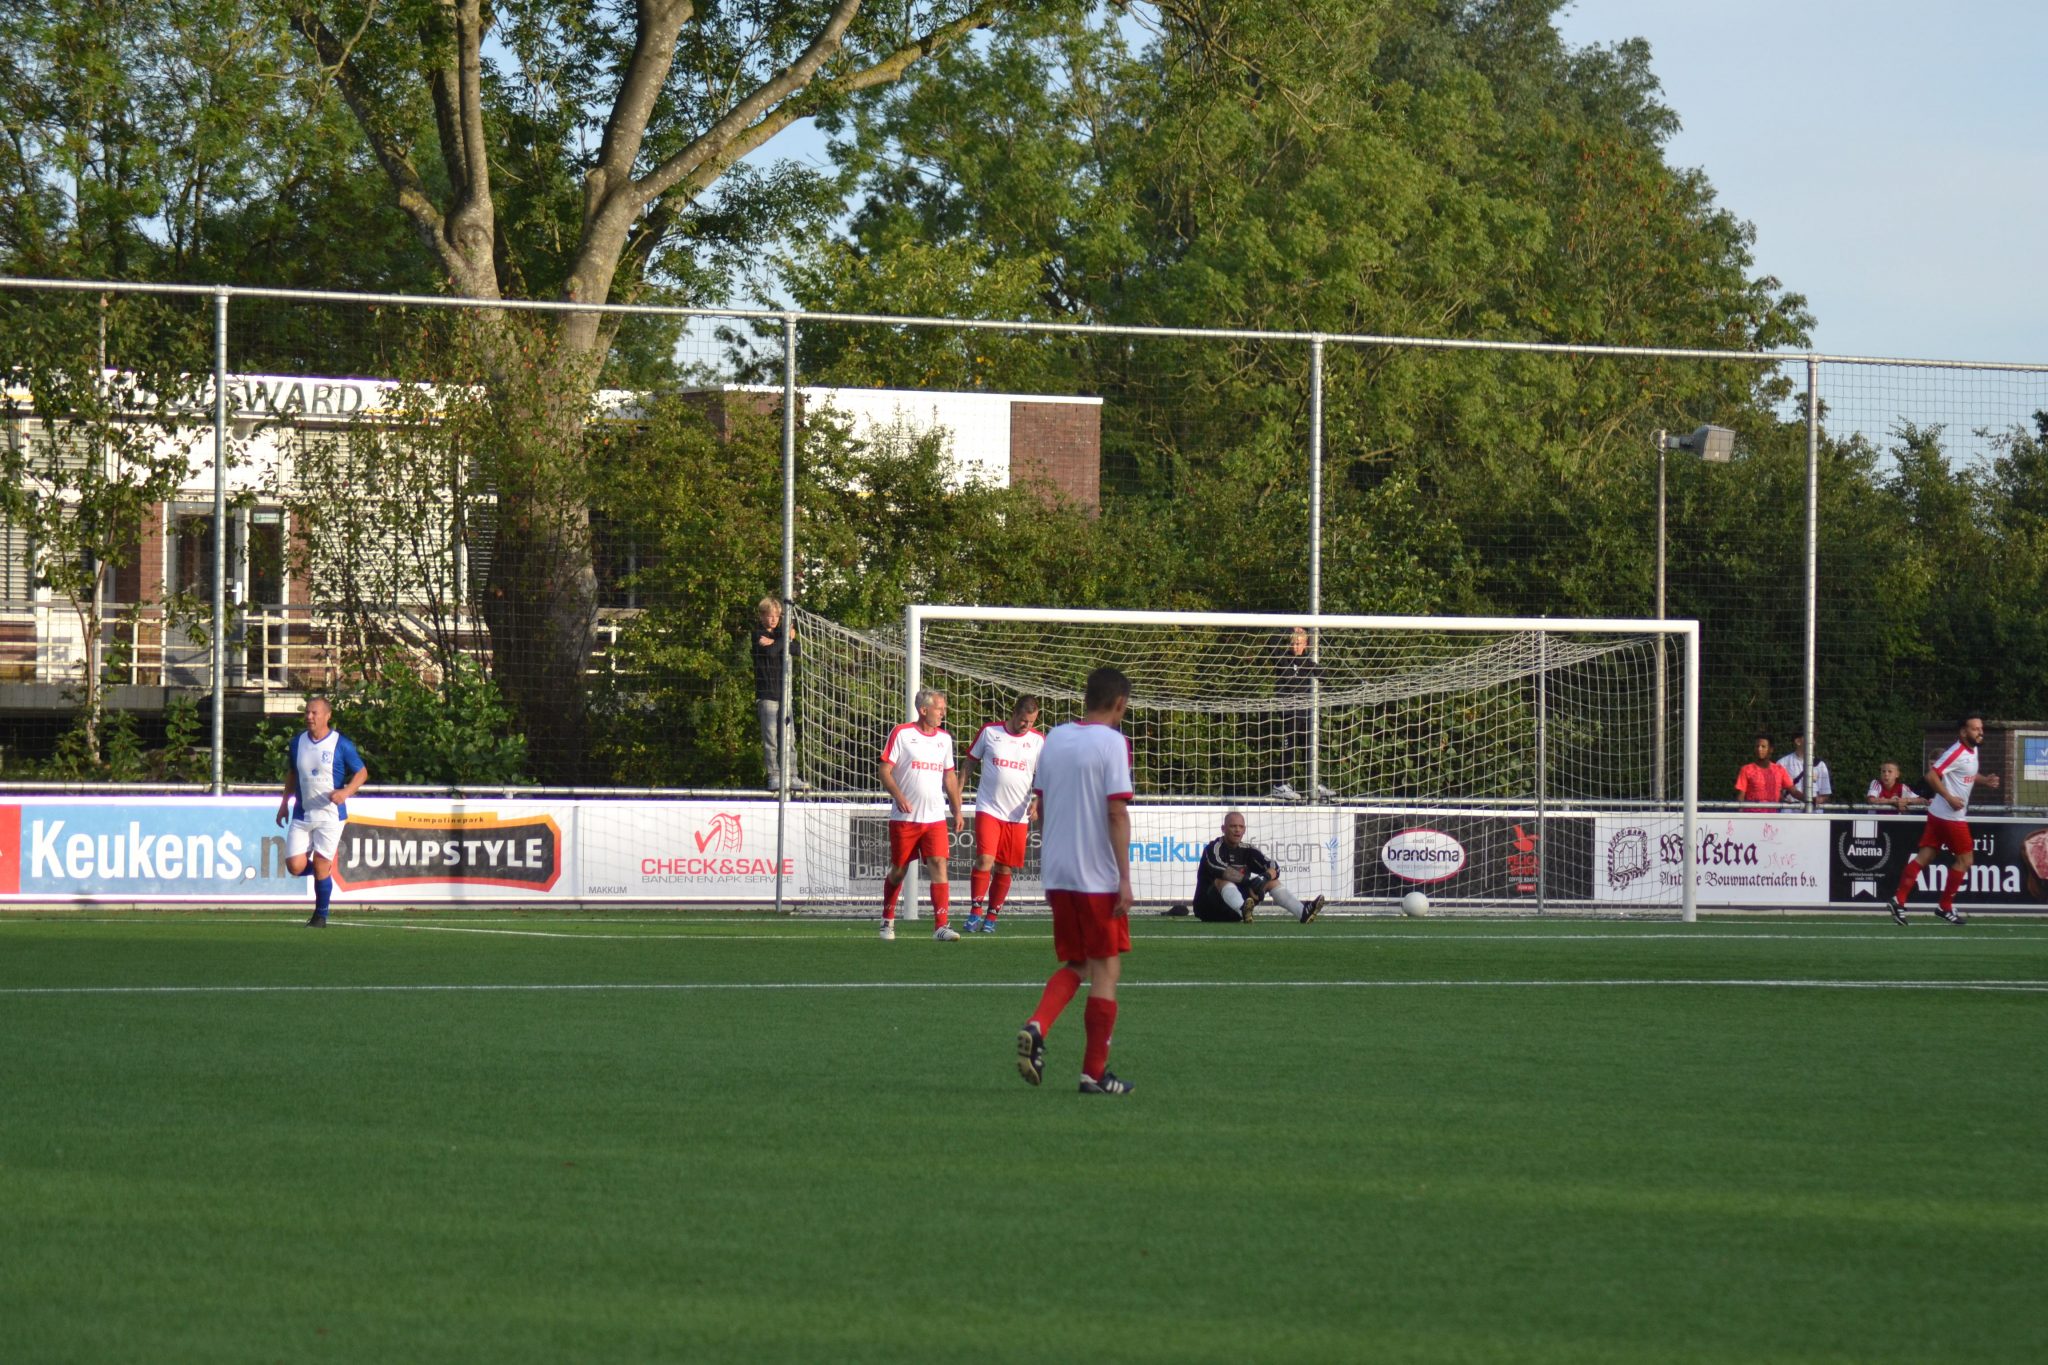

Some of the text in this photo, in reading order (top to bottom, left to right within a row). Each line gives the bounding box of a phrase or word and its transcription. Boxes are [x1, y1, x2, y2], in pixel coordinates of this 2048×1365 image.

[408, 816, 484, 824] Trampolinepark
[31, 820, 299, 885] Keukens.n
[348, 838, 543, 868] JUMPSTYLE
[1387, 846, 1459, 862] brandsma
[1847, 844, 1882, 856] Anema
[641, 858, 794, 875] CHECK&SAVE
[745, 876, 792, 884] SERVCE
[1705, 871, 1798, 887] Bouwmaterialen
[1800, 871, 1818, 887] b.v.
[589, 886, 627, 894] MAKKUM
[800, 886, 844, 895] BOLSWARD
